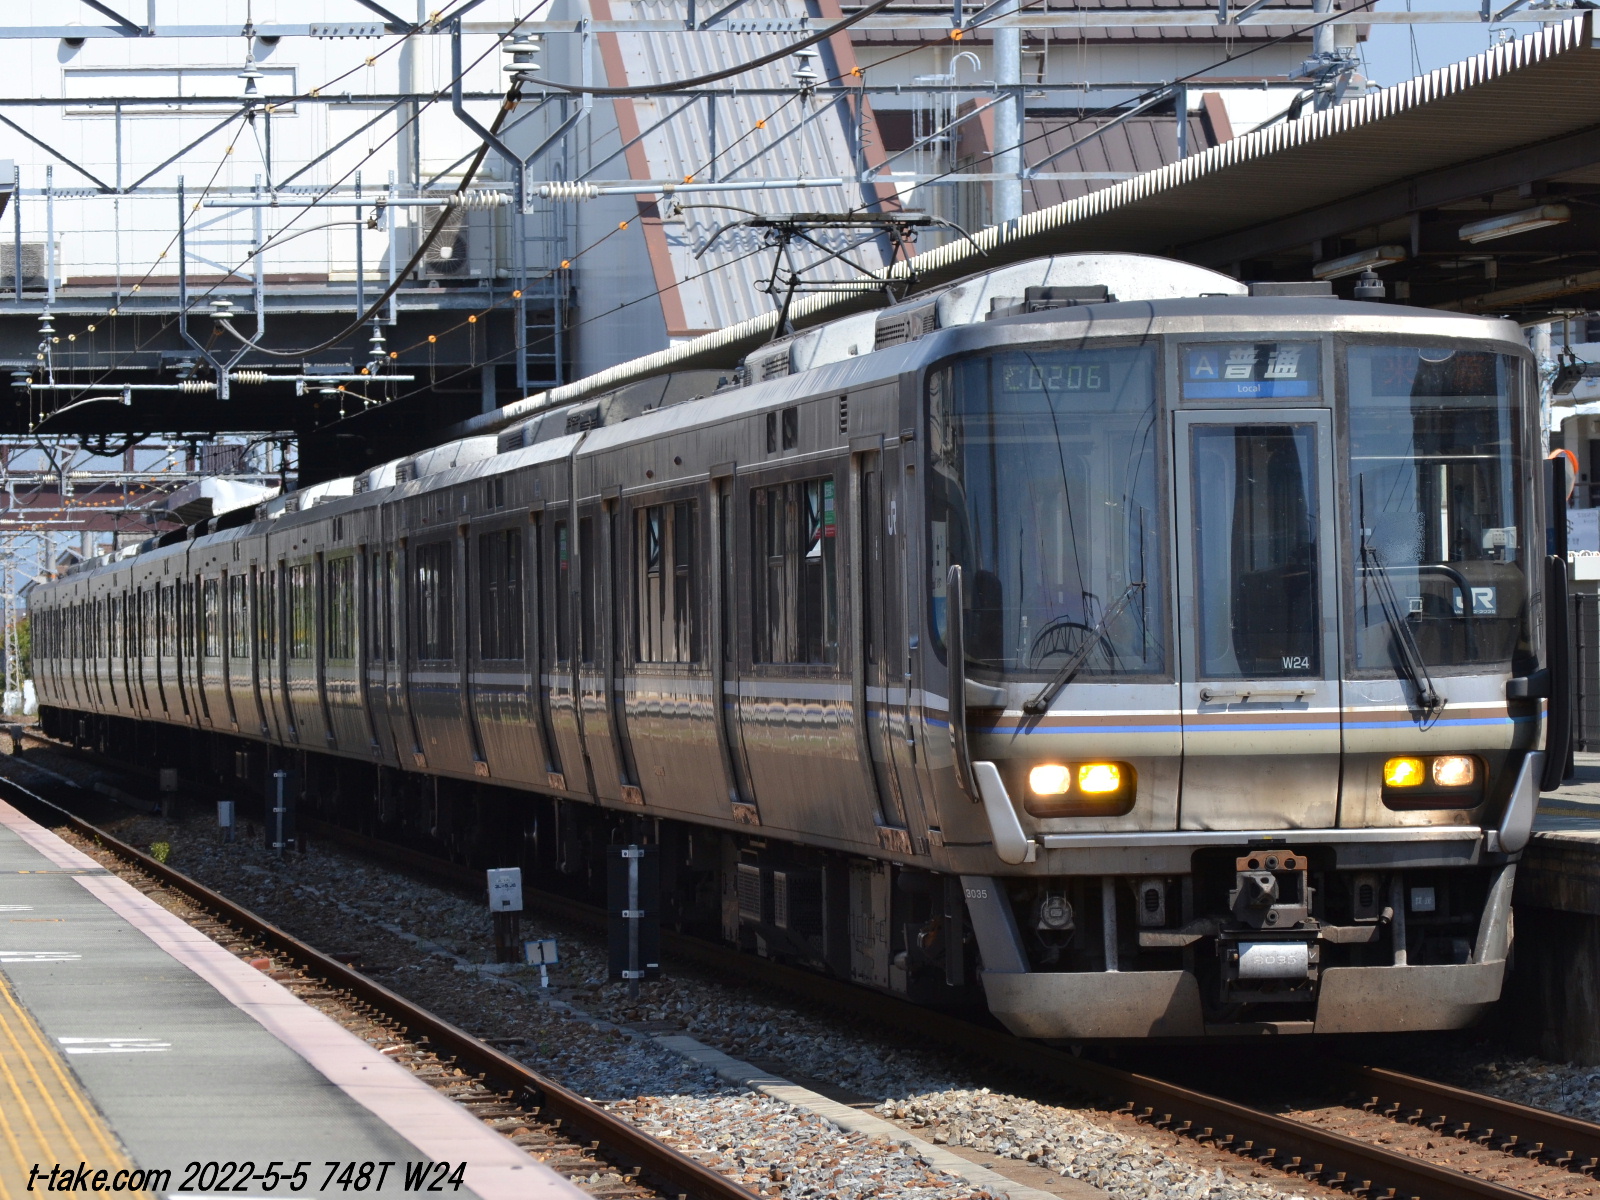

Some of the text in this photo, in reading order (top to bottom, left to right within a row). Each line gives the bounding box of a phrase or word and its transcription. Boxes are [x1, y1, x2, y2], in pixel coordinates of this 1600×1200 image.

[1194, 346, 1302, 379] A 普通
[1237, 384, 1261, 394] Local
[887, 500, 897, 536] JR
[1282, 656, 1310, 669] W24
[965, 888, 988, 899] 3035
[1253, 955, 1297, 965] 3035
